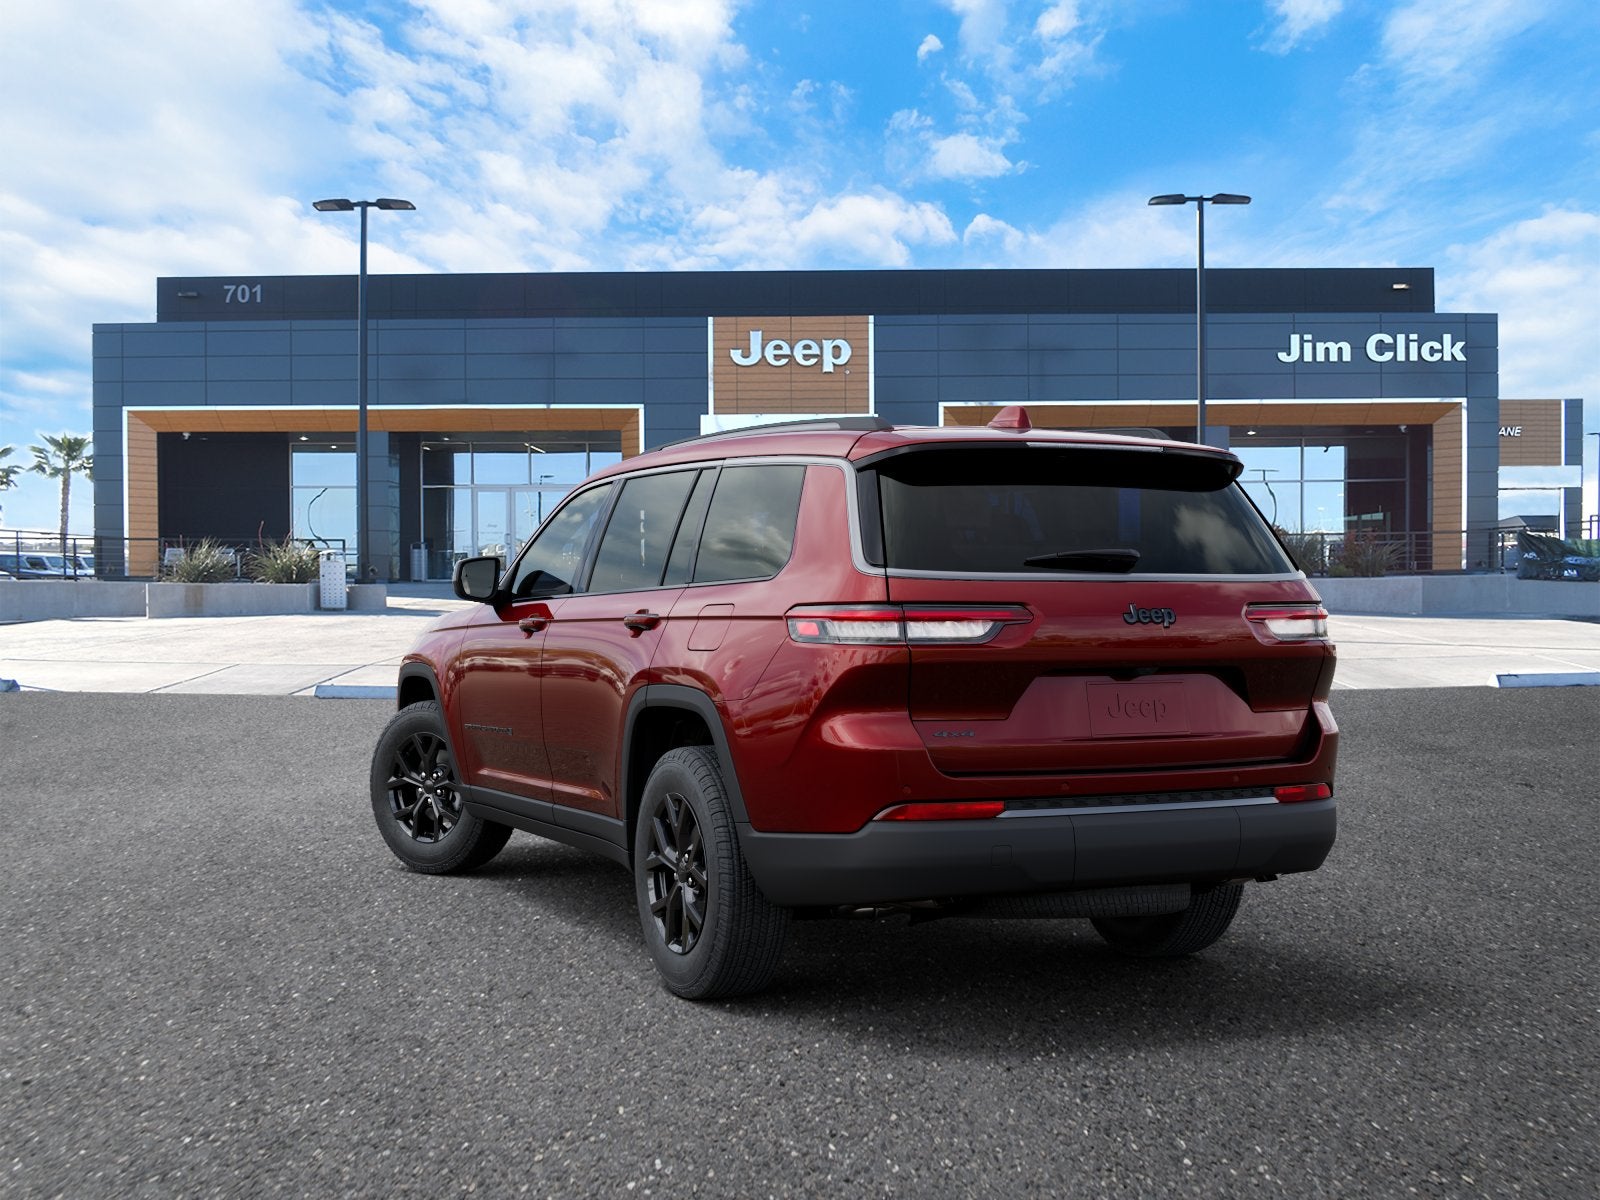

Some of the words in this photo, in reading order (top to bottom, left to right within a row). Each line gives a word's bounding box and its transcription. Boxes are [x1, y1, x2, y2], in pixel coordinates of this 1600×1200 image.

[223, 284, 262, 303] 701
[729, 330, 852, 373] Jeep
[1277, 333, 1352, 363] Jim
[1365, 333, 1467, 362] Click
[1123, 603, 1176, 628] Jeep
[1107, 690, 1167, 723] Jeep
